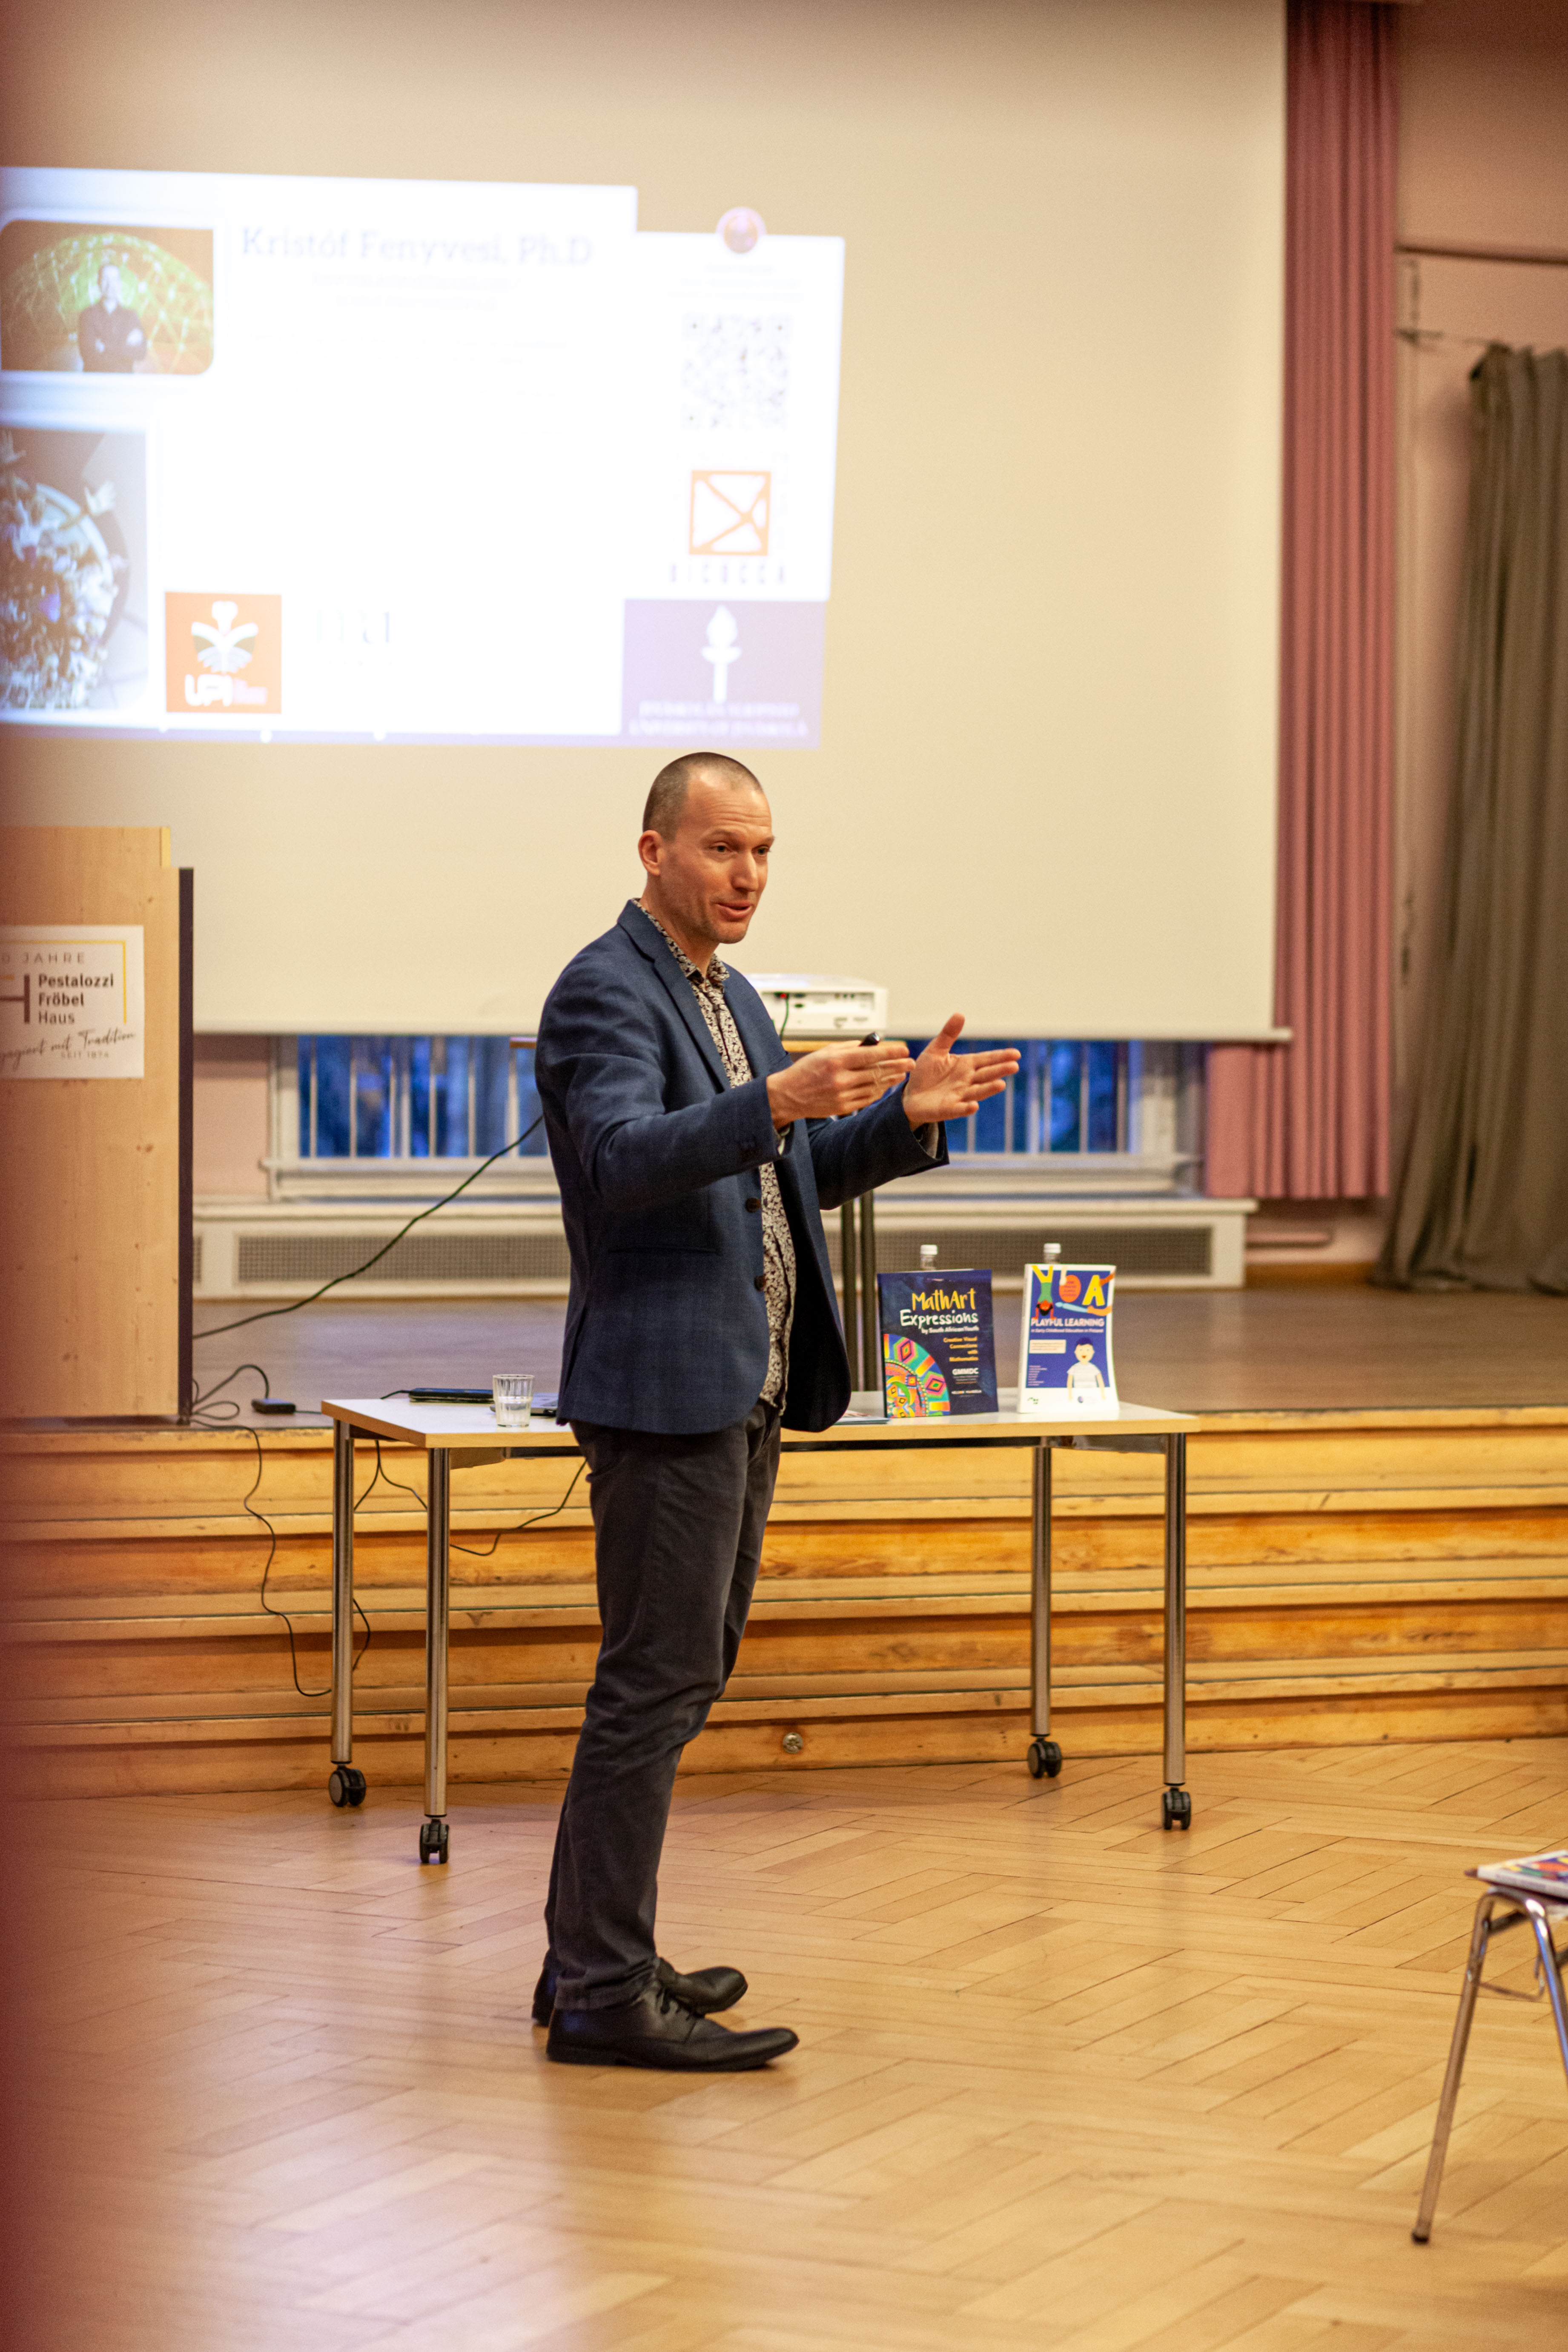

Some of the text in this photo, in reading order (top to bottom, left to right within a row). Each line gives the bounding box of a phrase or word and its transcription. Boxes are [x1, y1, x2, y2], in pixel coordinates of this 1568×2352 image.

[22, 952, 84, 964] JAHRE
[38, 973, 114, 988] Pestalozzi
[38, 992, 85, 1007] Fröbel
[38, 1011, 75, 1024] Haus
[77, 1026, 135, 1049] Tradition
[912, 1287, 976, 1312] MathArt
[900, 1309, 979, 1329] Expressions
[1030, 1318, 1105, 1327] PLAYFUL LEARNING
